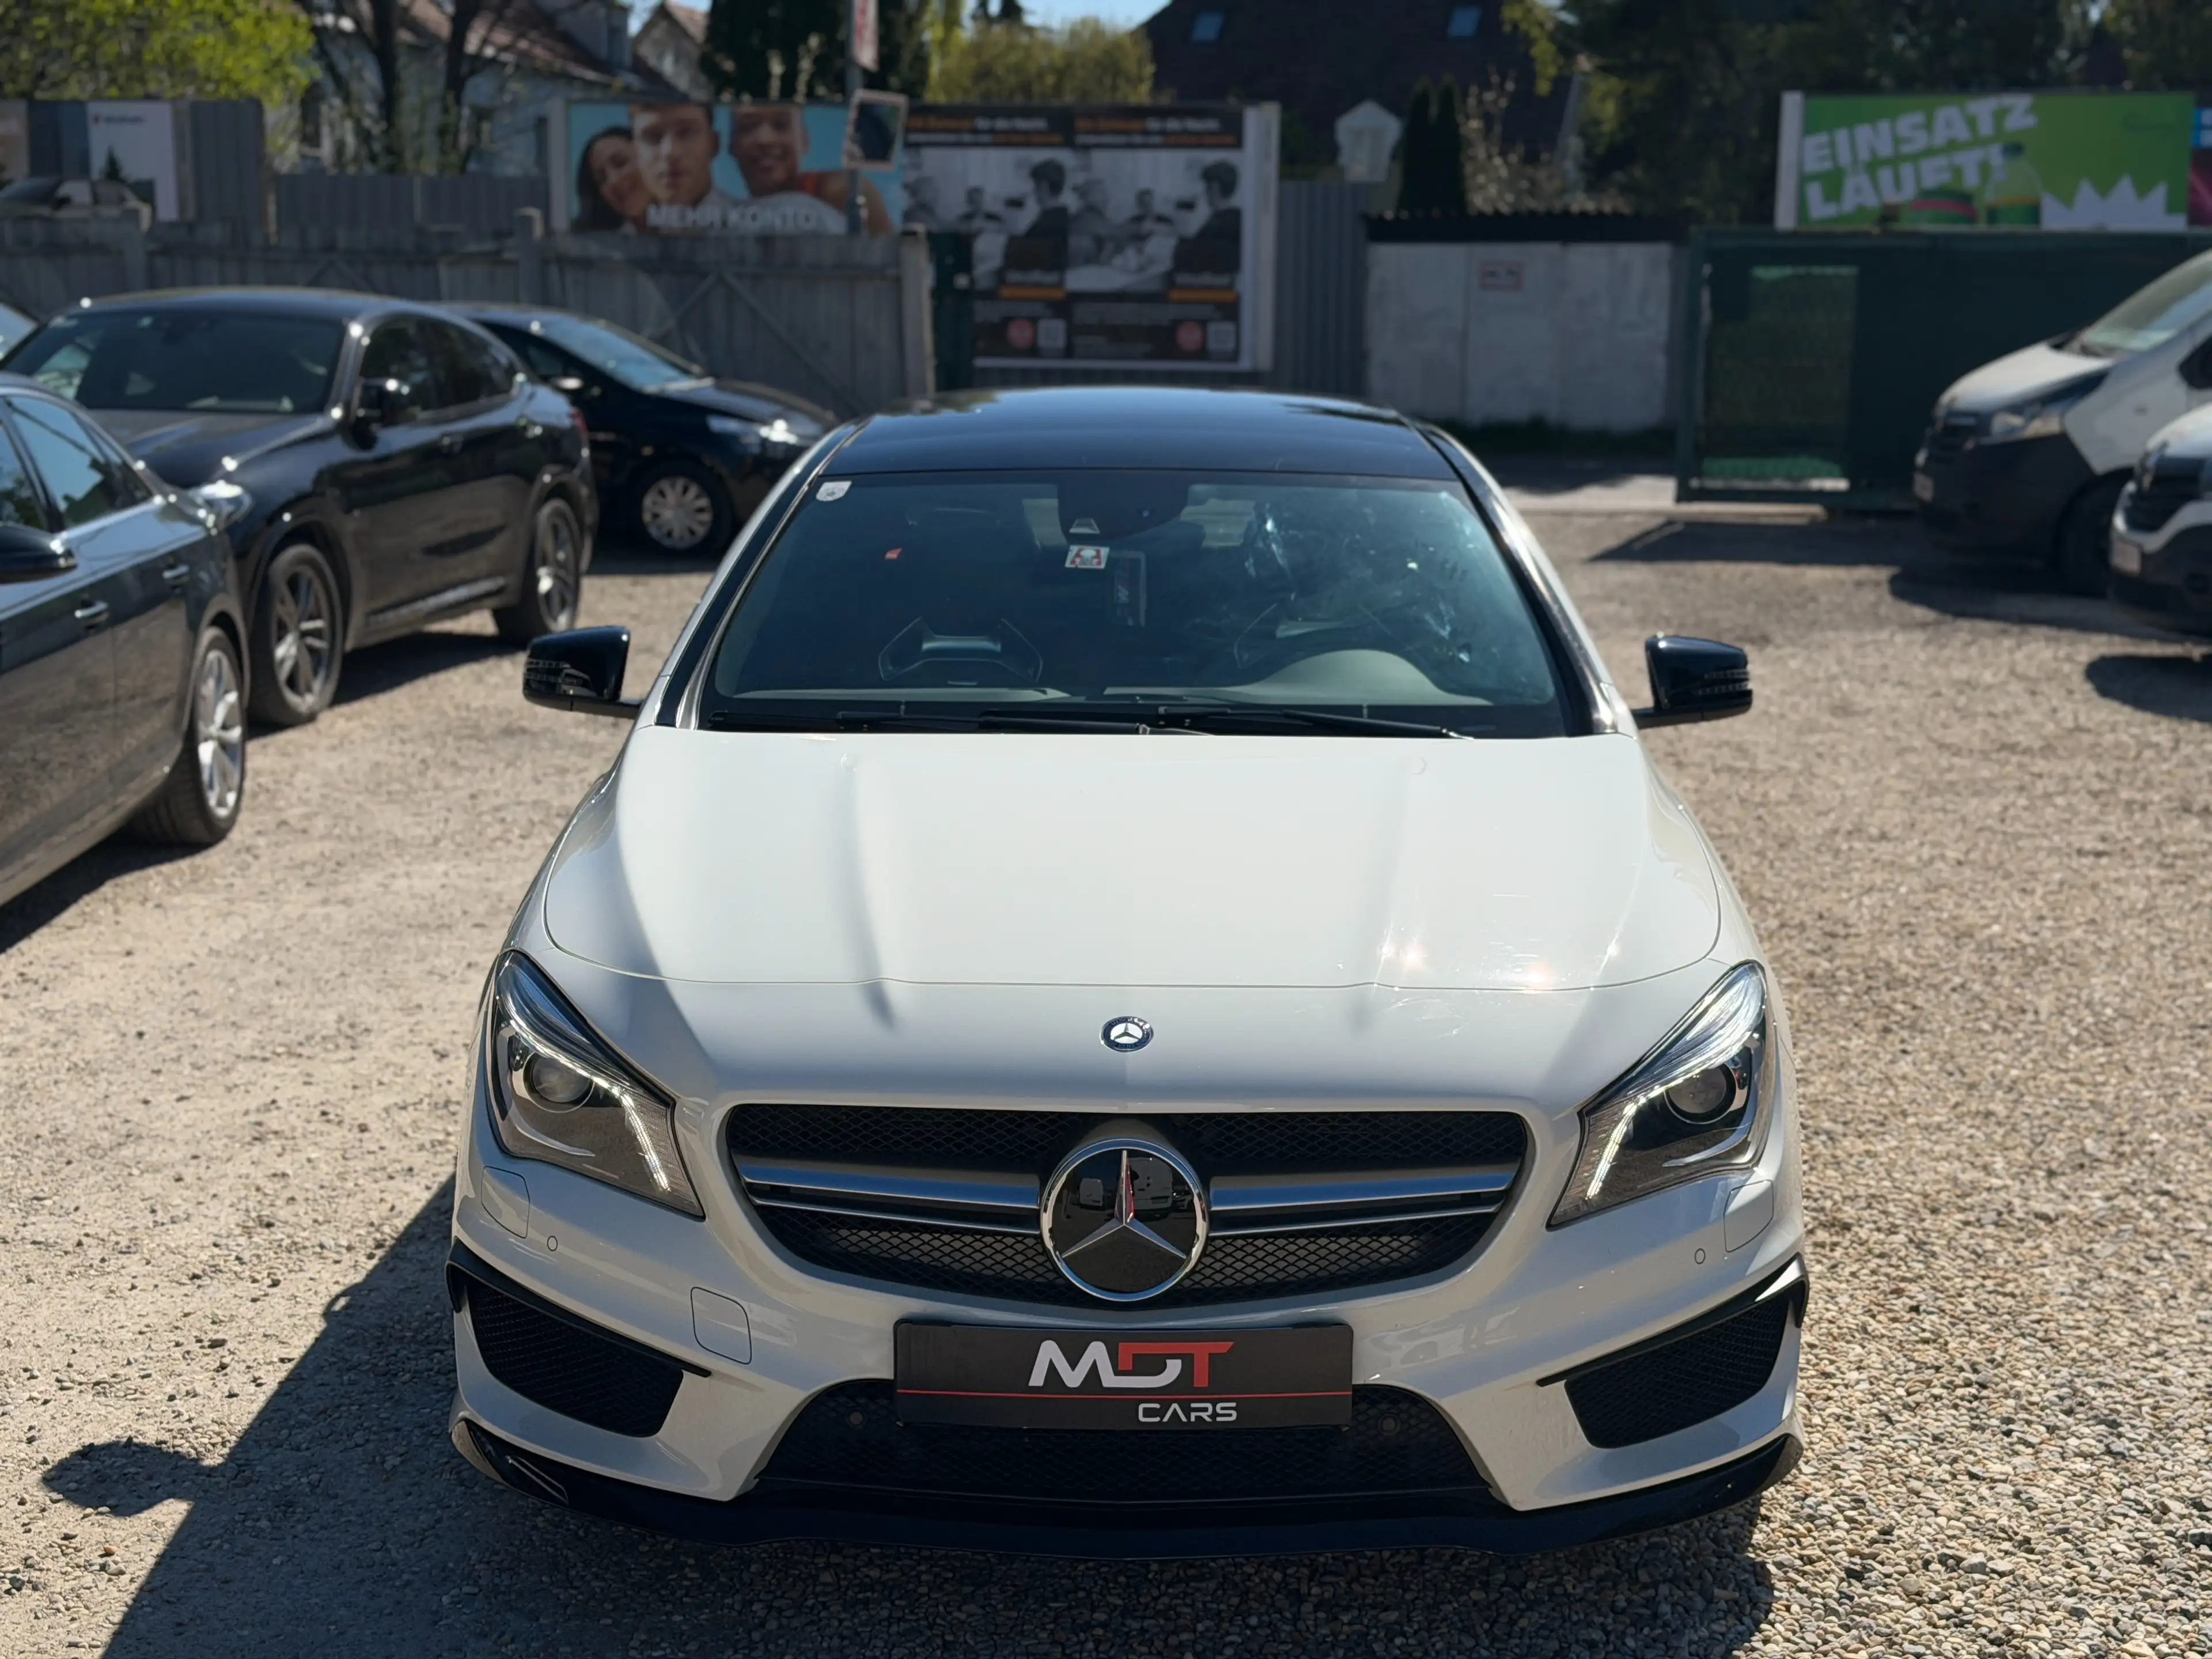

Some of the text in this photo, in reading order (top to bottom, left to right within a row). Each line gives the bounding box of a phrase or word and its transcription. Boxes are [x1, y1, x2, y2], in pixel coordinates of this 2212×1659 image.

[1804, 93, 2036, 173] EINSATZ
[1028, 1340, 1234, 1388] MDT
[1138, 1402, 1237, 1422] CARS
